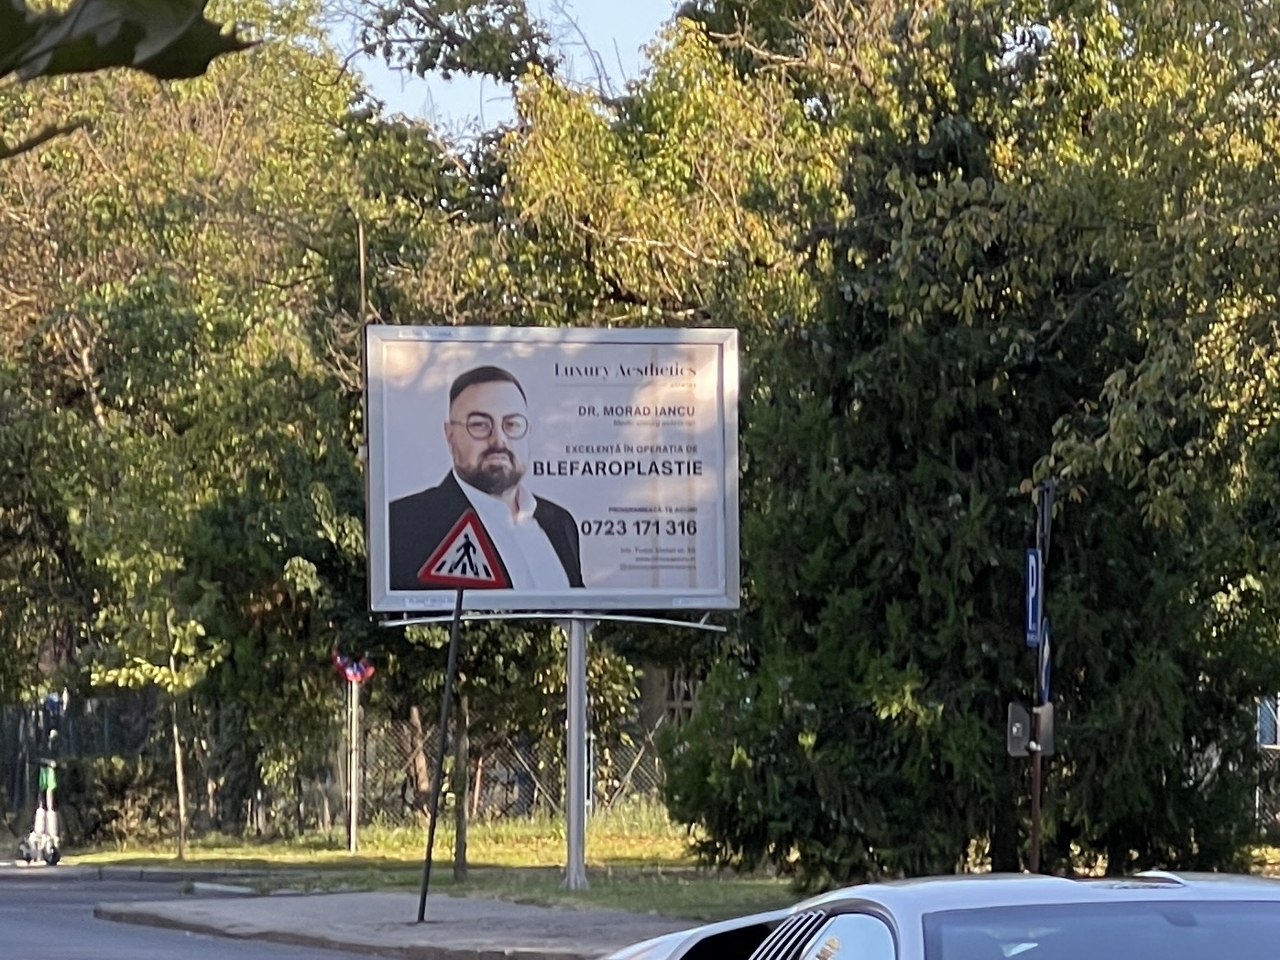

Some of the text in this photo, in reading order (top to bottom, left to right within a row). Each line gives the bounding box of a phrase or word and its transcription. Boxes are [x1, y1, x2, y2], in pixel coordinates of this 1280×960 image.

[555, 361, 697, 381] Luxury Aesthetics
[578, 405, 695, 417] DR. MORAD IANCU
[532, 460, 703, 477] BLEFAROPLASTIE
[581, 520, 698, 536] 0723 171 316
[1028, 553, 1037, 631] P
